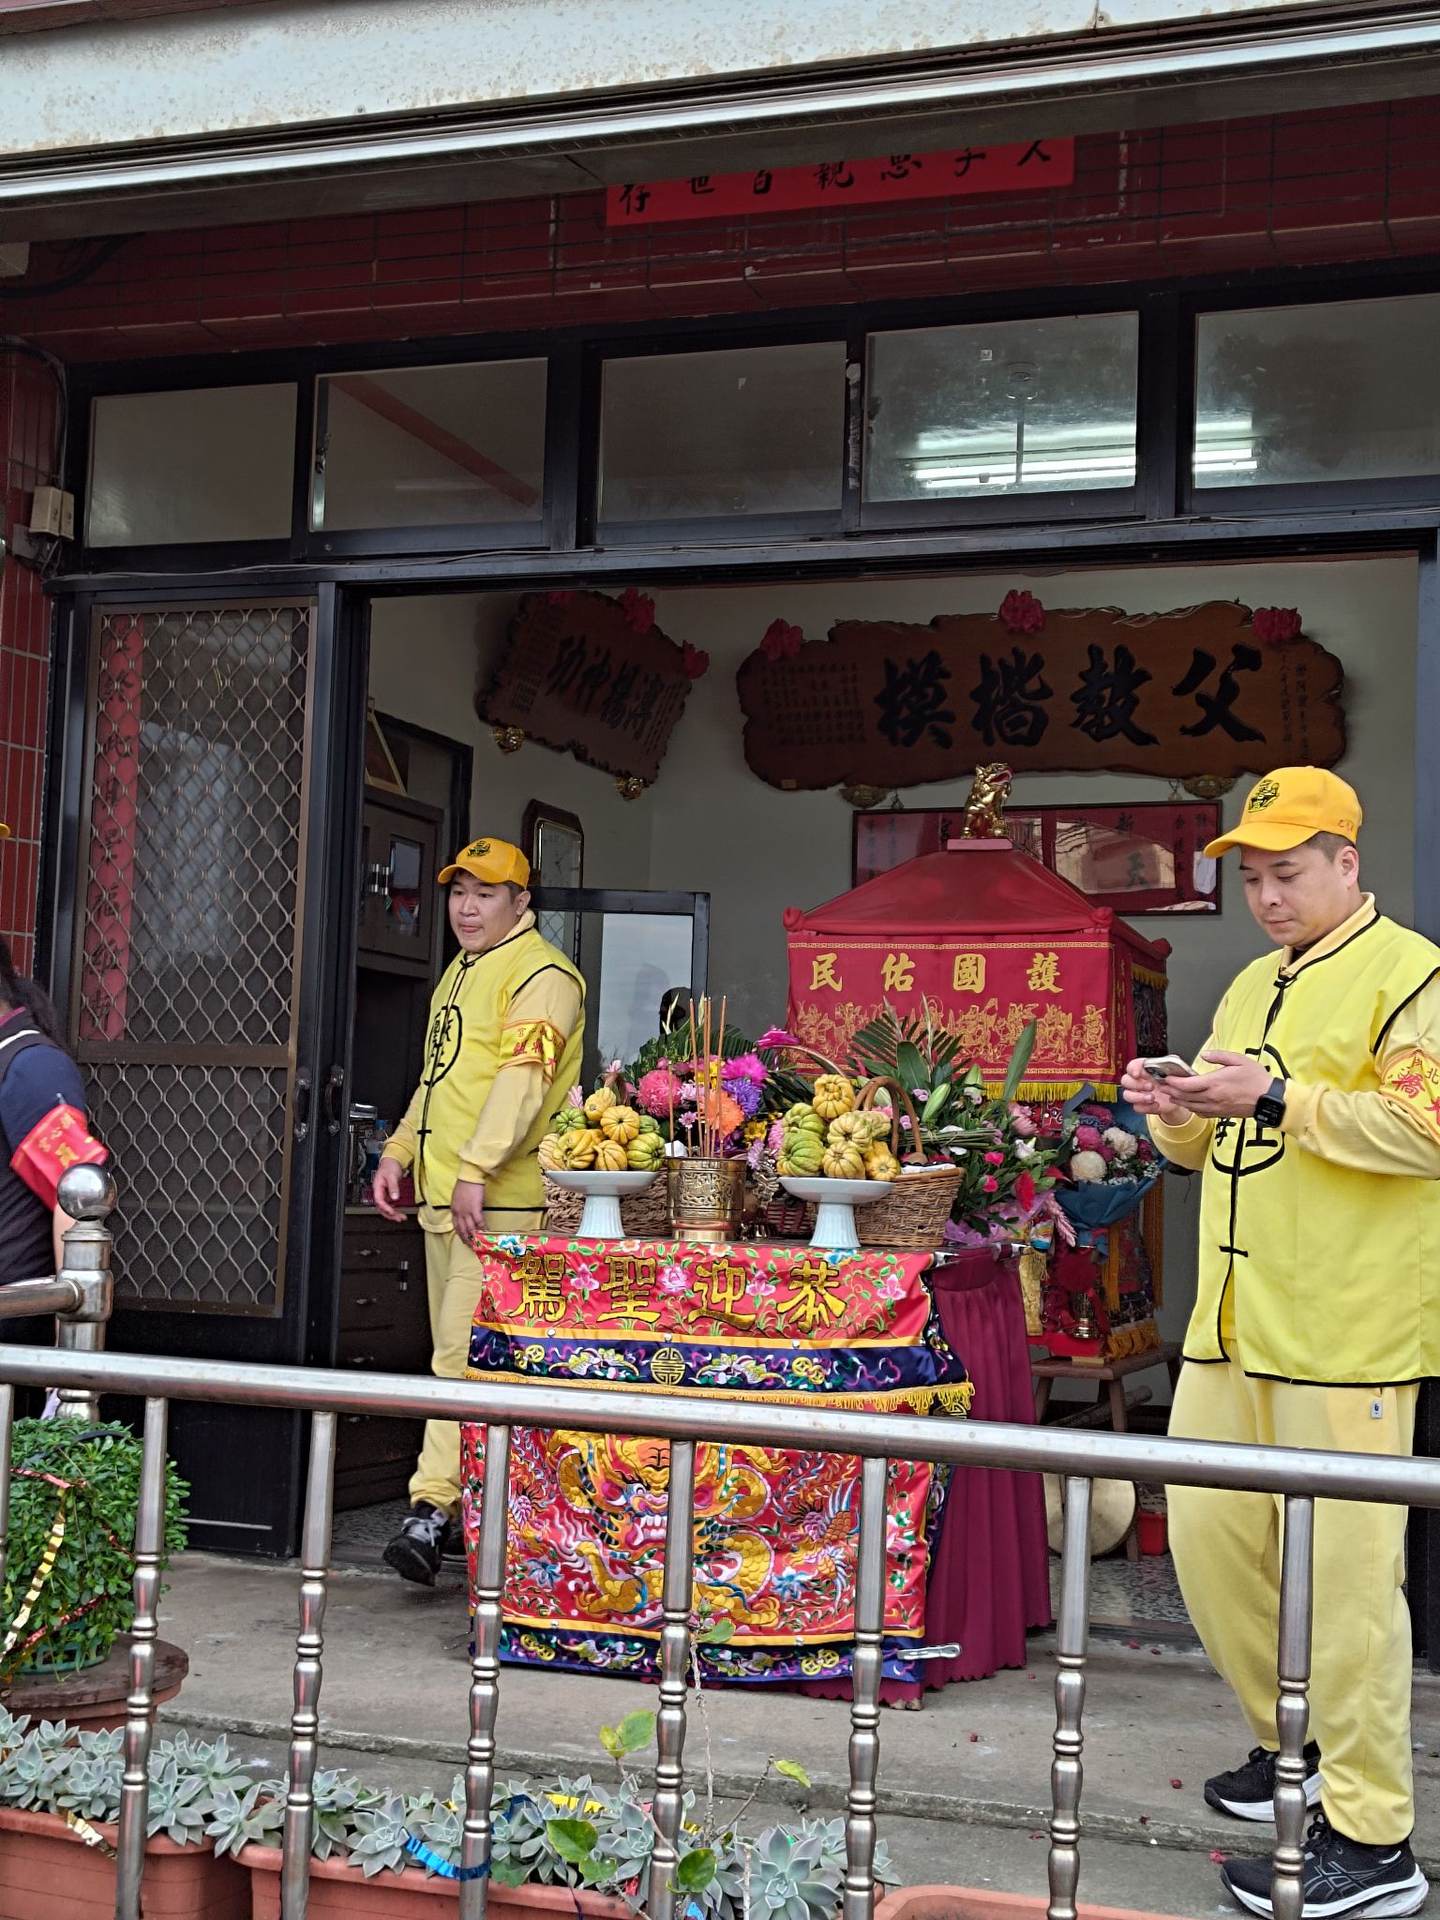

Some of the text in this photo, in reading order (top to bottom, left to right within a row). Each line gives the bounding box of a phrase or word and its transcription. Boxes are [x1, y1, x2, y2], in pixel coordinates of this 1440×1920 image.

[808, 952, 1064, 994] 護國佑民
[509, 1252, 847, 1332] 恭迎聖駕
